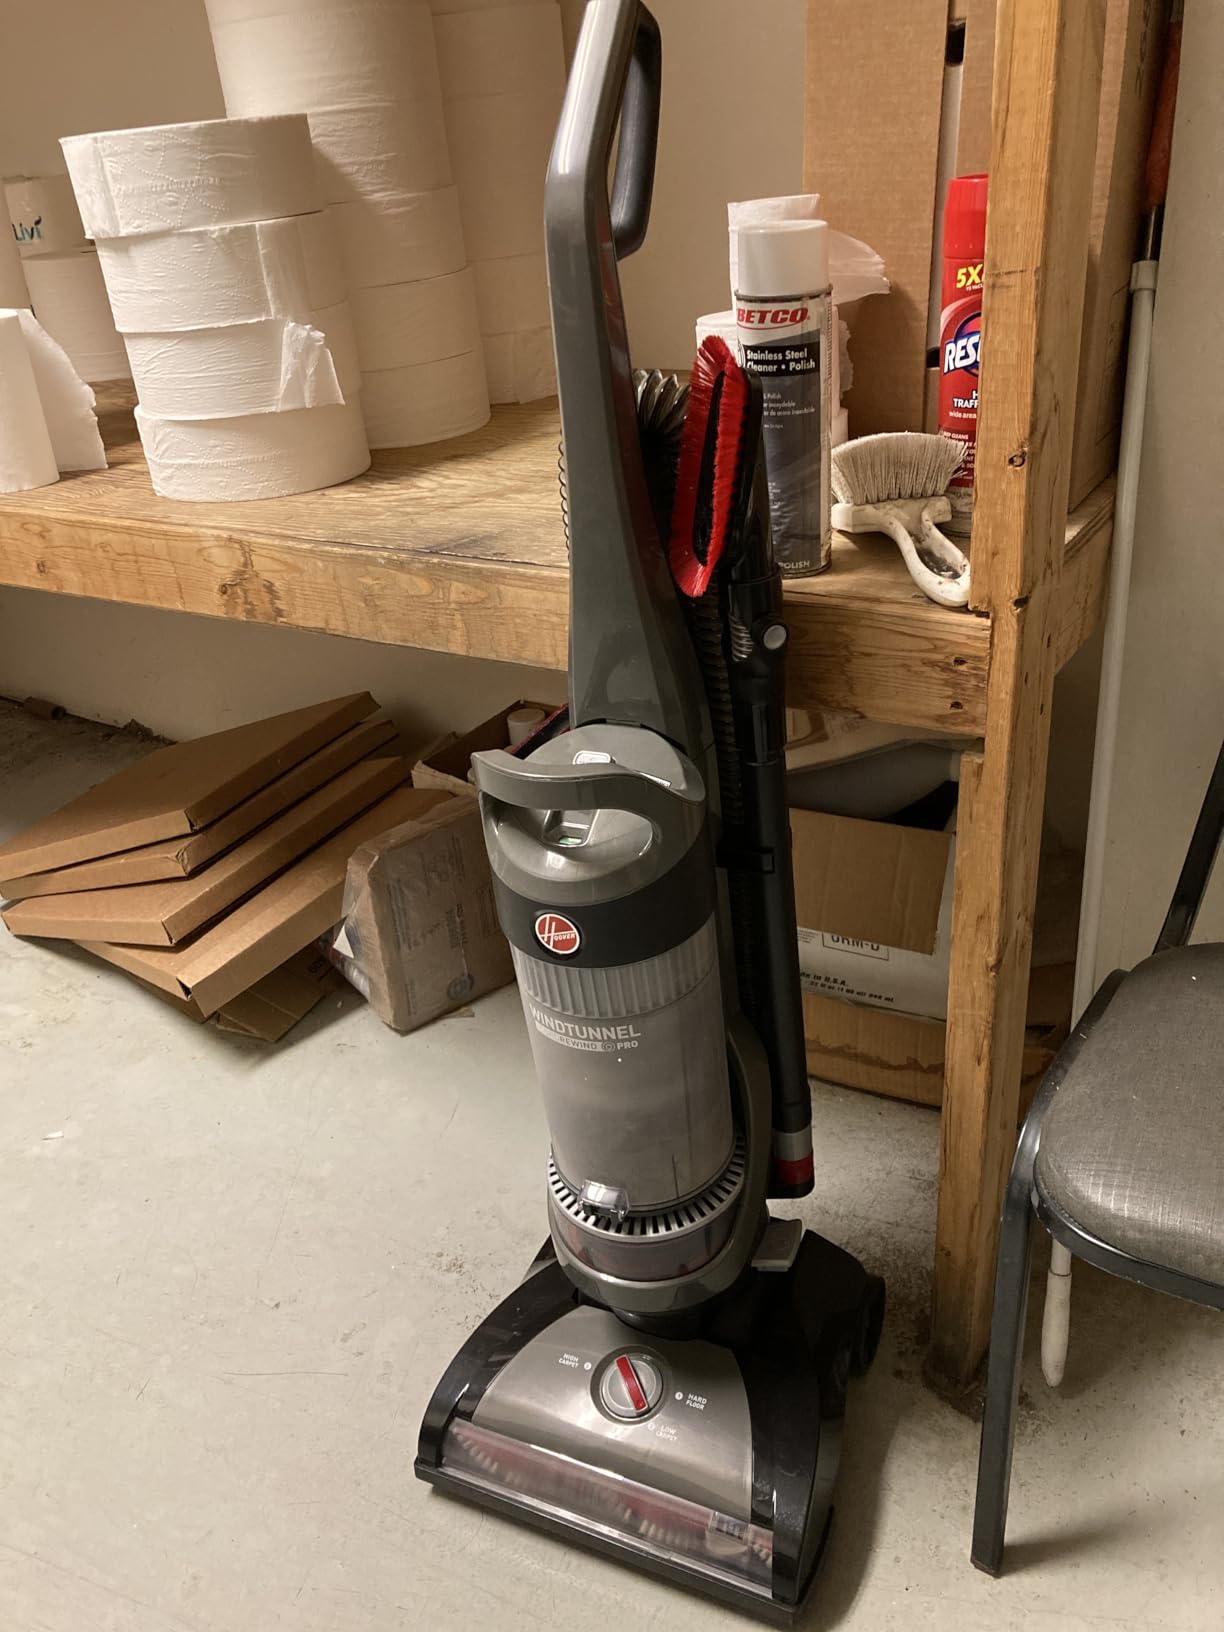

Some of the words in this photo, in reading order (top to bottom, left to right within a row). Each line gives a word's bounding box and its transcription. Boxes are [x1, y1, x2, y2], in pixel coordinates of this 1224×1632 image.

[736, 307, 809, 324] BETCO
[746, 350, 783, 361] Stainless
[785, 348, 808, 359] Steel
[746, 362, 778, 372] Cleaner
[789, 359, 816, 371] Polish
[529, 1003, 642, 1040] WINDTUNNEL
[559, 1036, 598, 1051] REWIND
[617, 1040, 639, 1051] PRO
[685, 1399, 705, 1410] FLOOR
[687, 1393, 707, 1404] HARD
